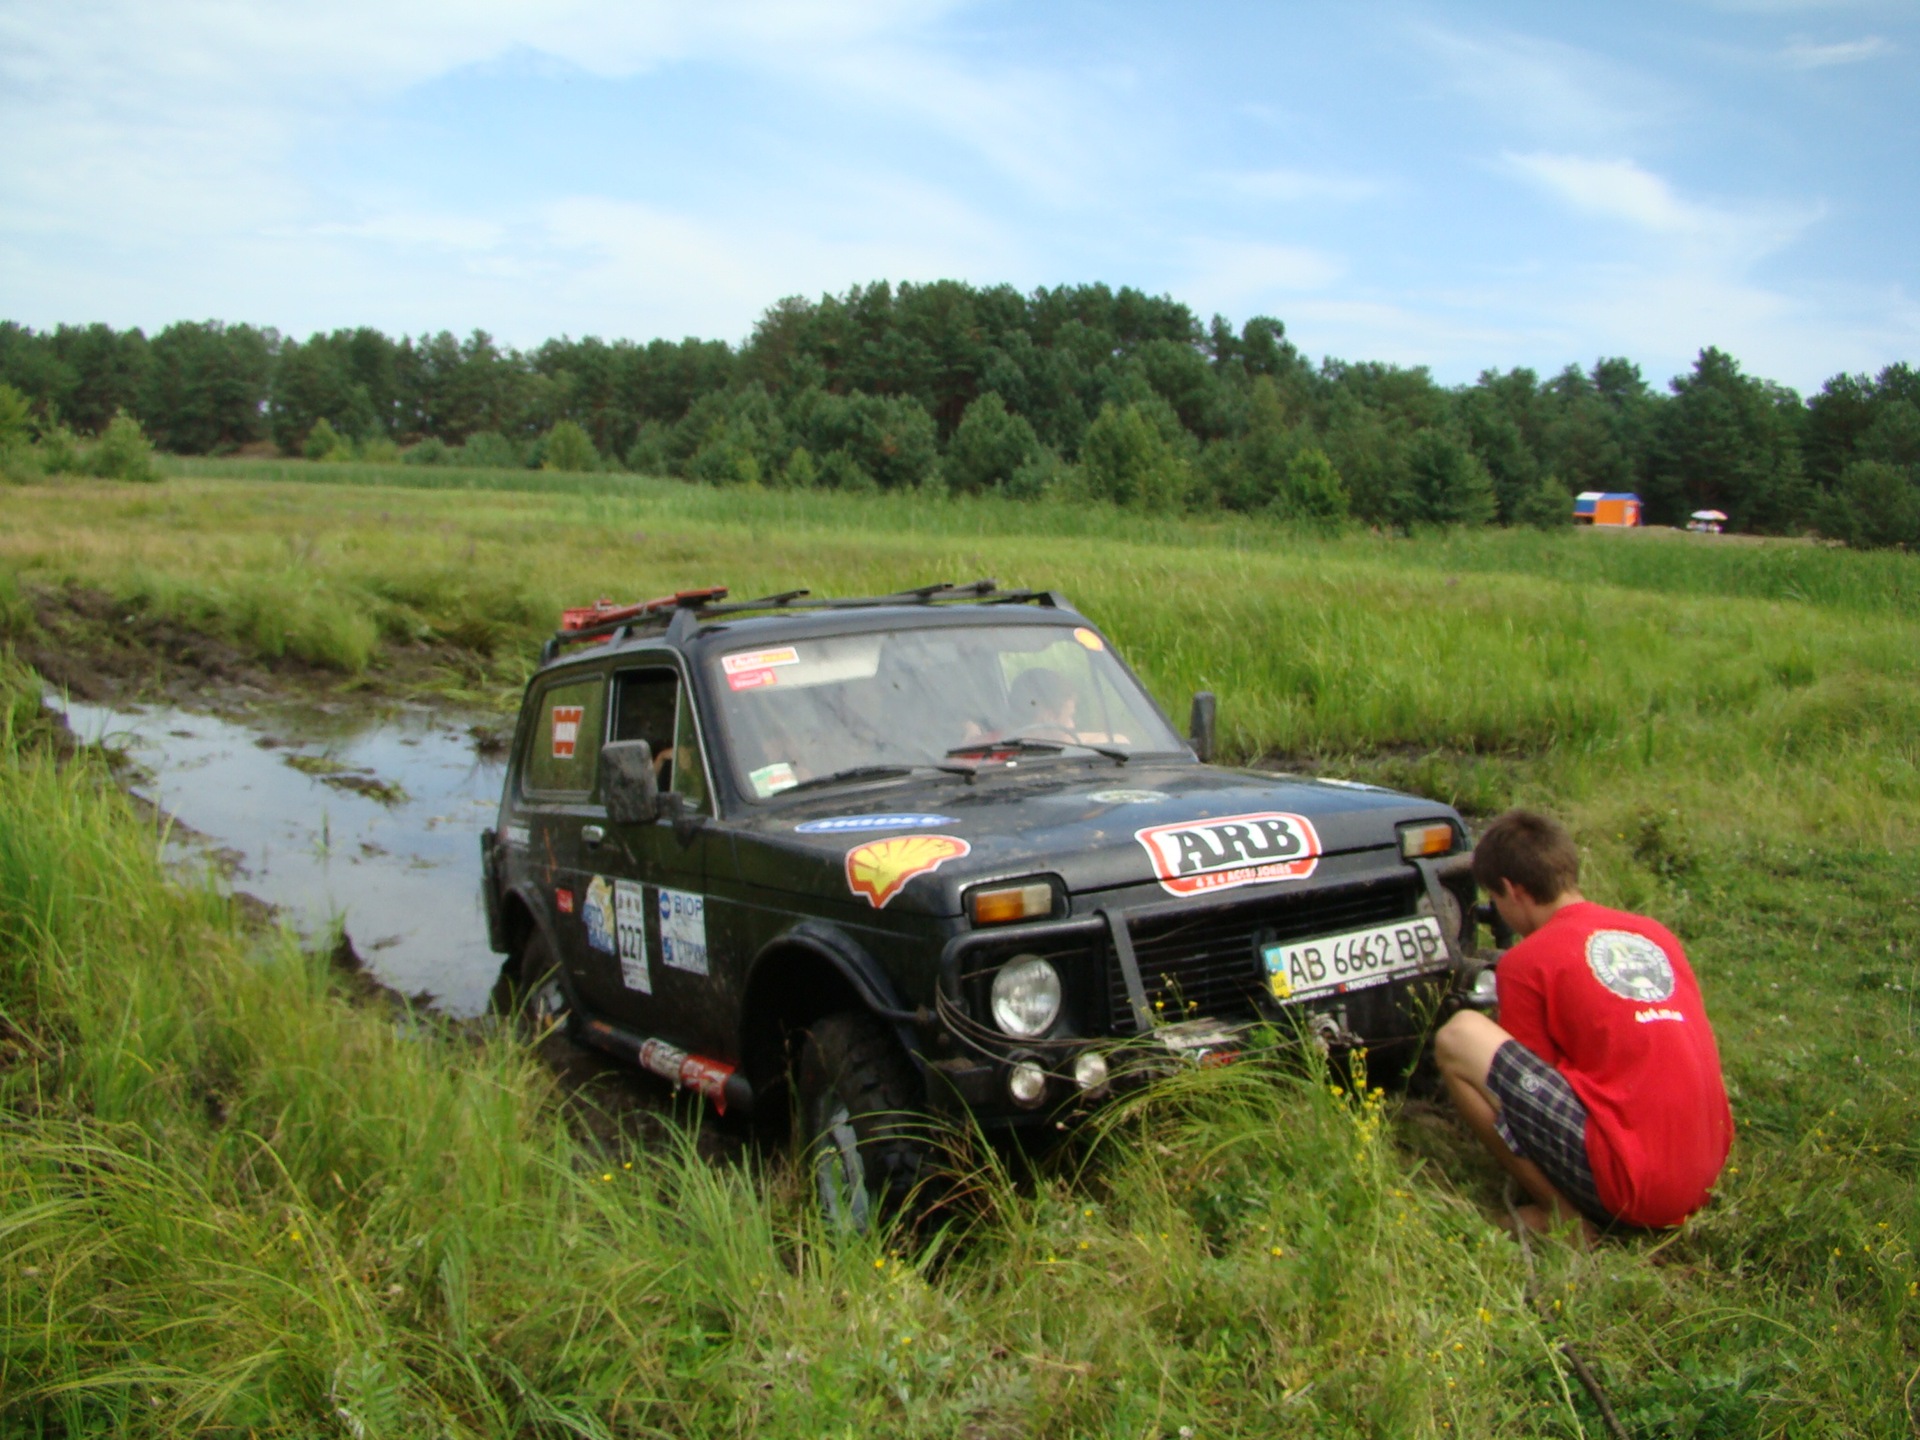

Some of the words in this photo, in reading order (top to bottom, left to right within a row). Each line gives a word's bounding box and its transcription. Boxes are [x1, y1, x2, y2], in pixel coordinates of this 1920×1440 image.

[1166, 819, 1302, 875] ARB
[619, 923, 643, 961] 227
[1290, 947, 1327, 986] AB
[1334, 933, 1394, 975] 6662
[1395, 924, 1438, 961] BB
